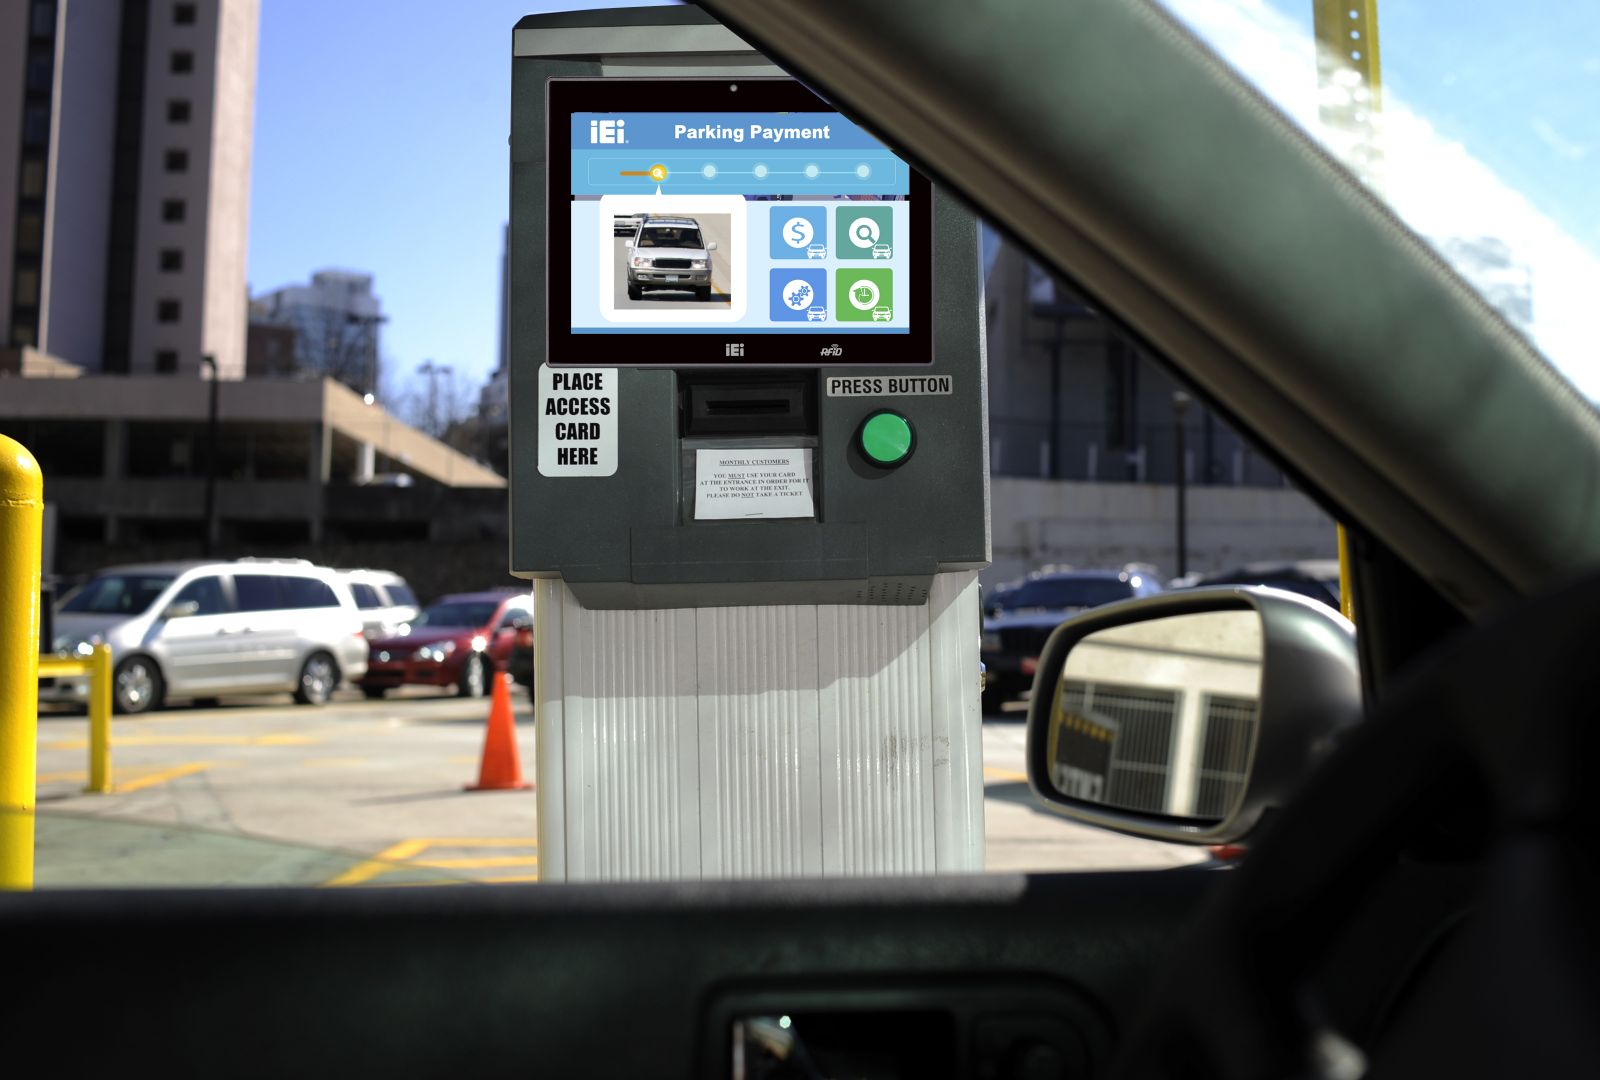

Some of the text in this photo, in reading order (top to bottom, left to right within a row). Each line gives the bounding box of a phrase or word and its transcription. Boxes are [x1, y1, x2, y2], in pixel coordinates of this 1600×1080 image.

[674, 124, 744, 142] Parking
[750, 124, 830, 142] Payment
[552, 372, 603, 390] PLACE
[831, 377, 949, 394] PRESS BUTTON
[545, 397, 611, 416] ACCESS
[555, 422, 601, 441] CARD
[557, 447, 598, 465] HERE
